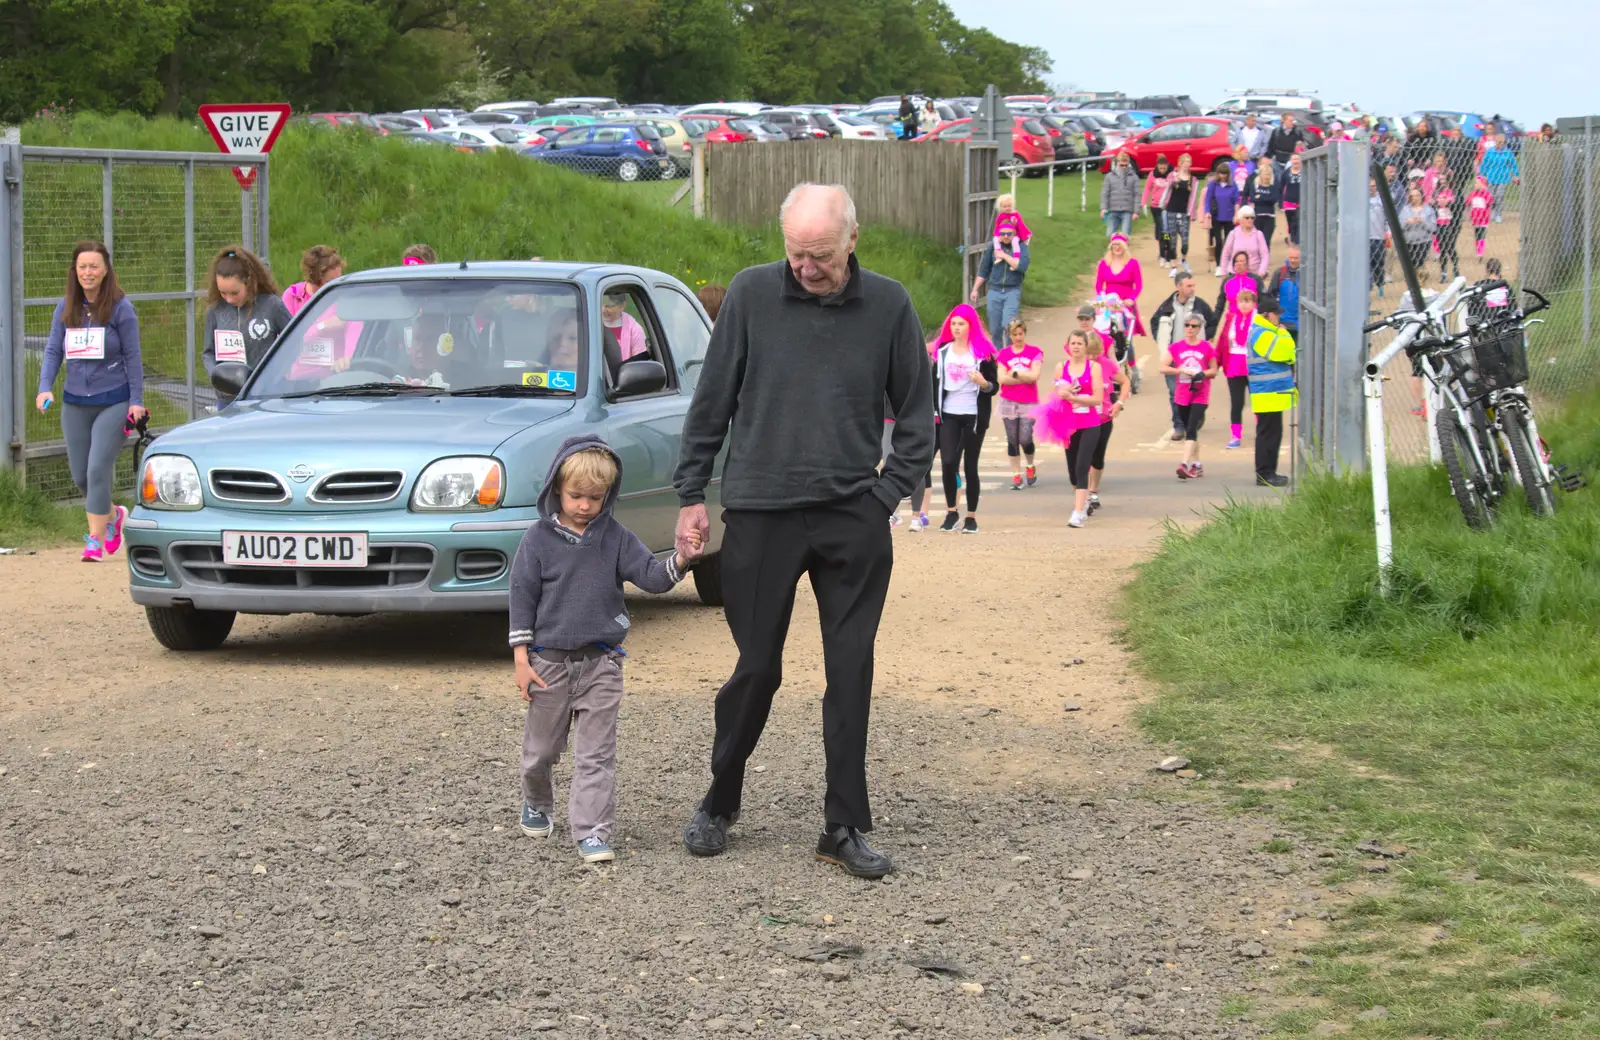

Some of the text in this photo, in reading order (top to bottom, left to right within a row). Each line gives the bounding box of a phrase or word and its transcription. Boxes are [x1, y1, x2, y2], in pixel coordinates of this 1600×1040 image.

[220, 116, 269, 132] GIVE
[231, 136, 262, 148] WAY
[236, 535, 354, 560] AU02 CWD
